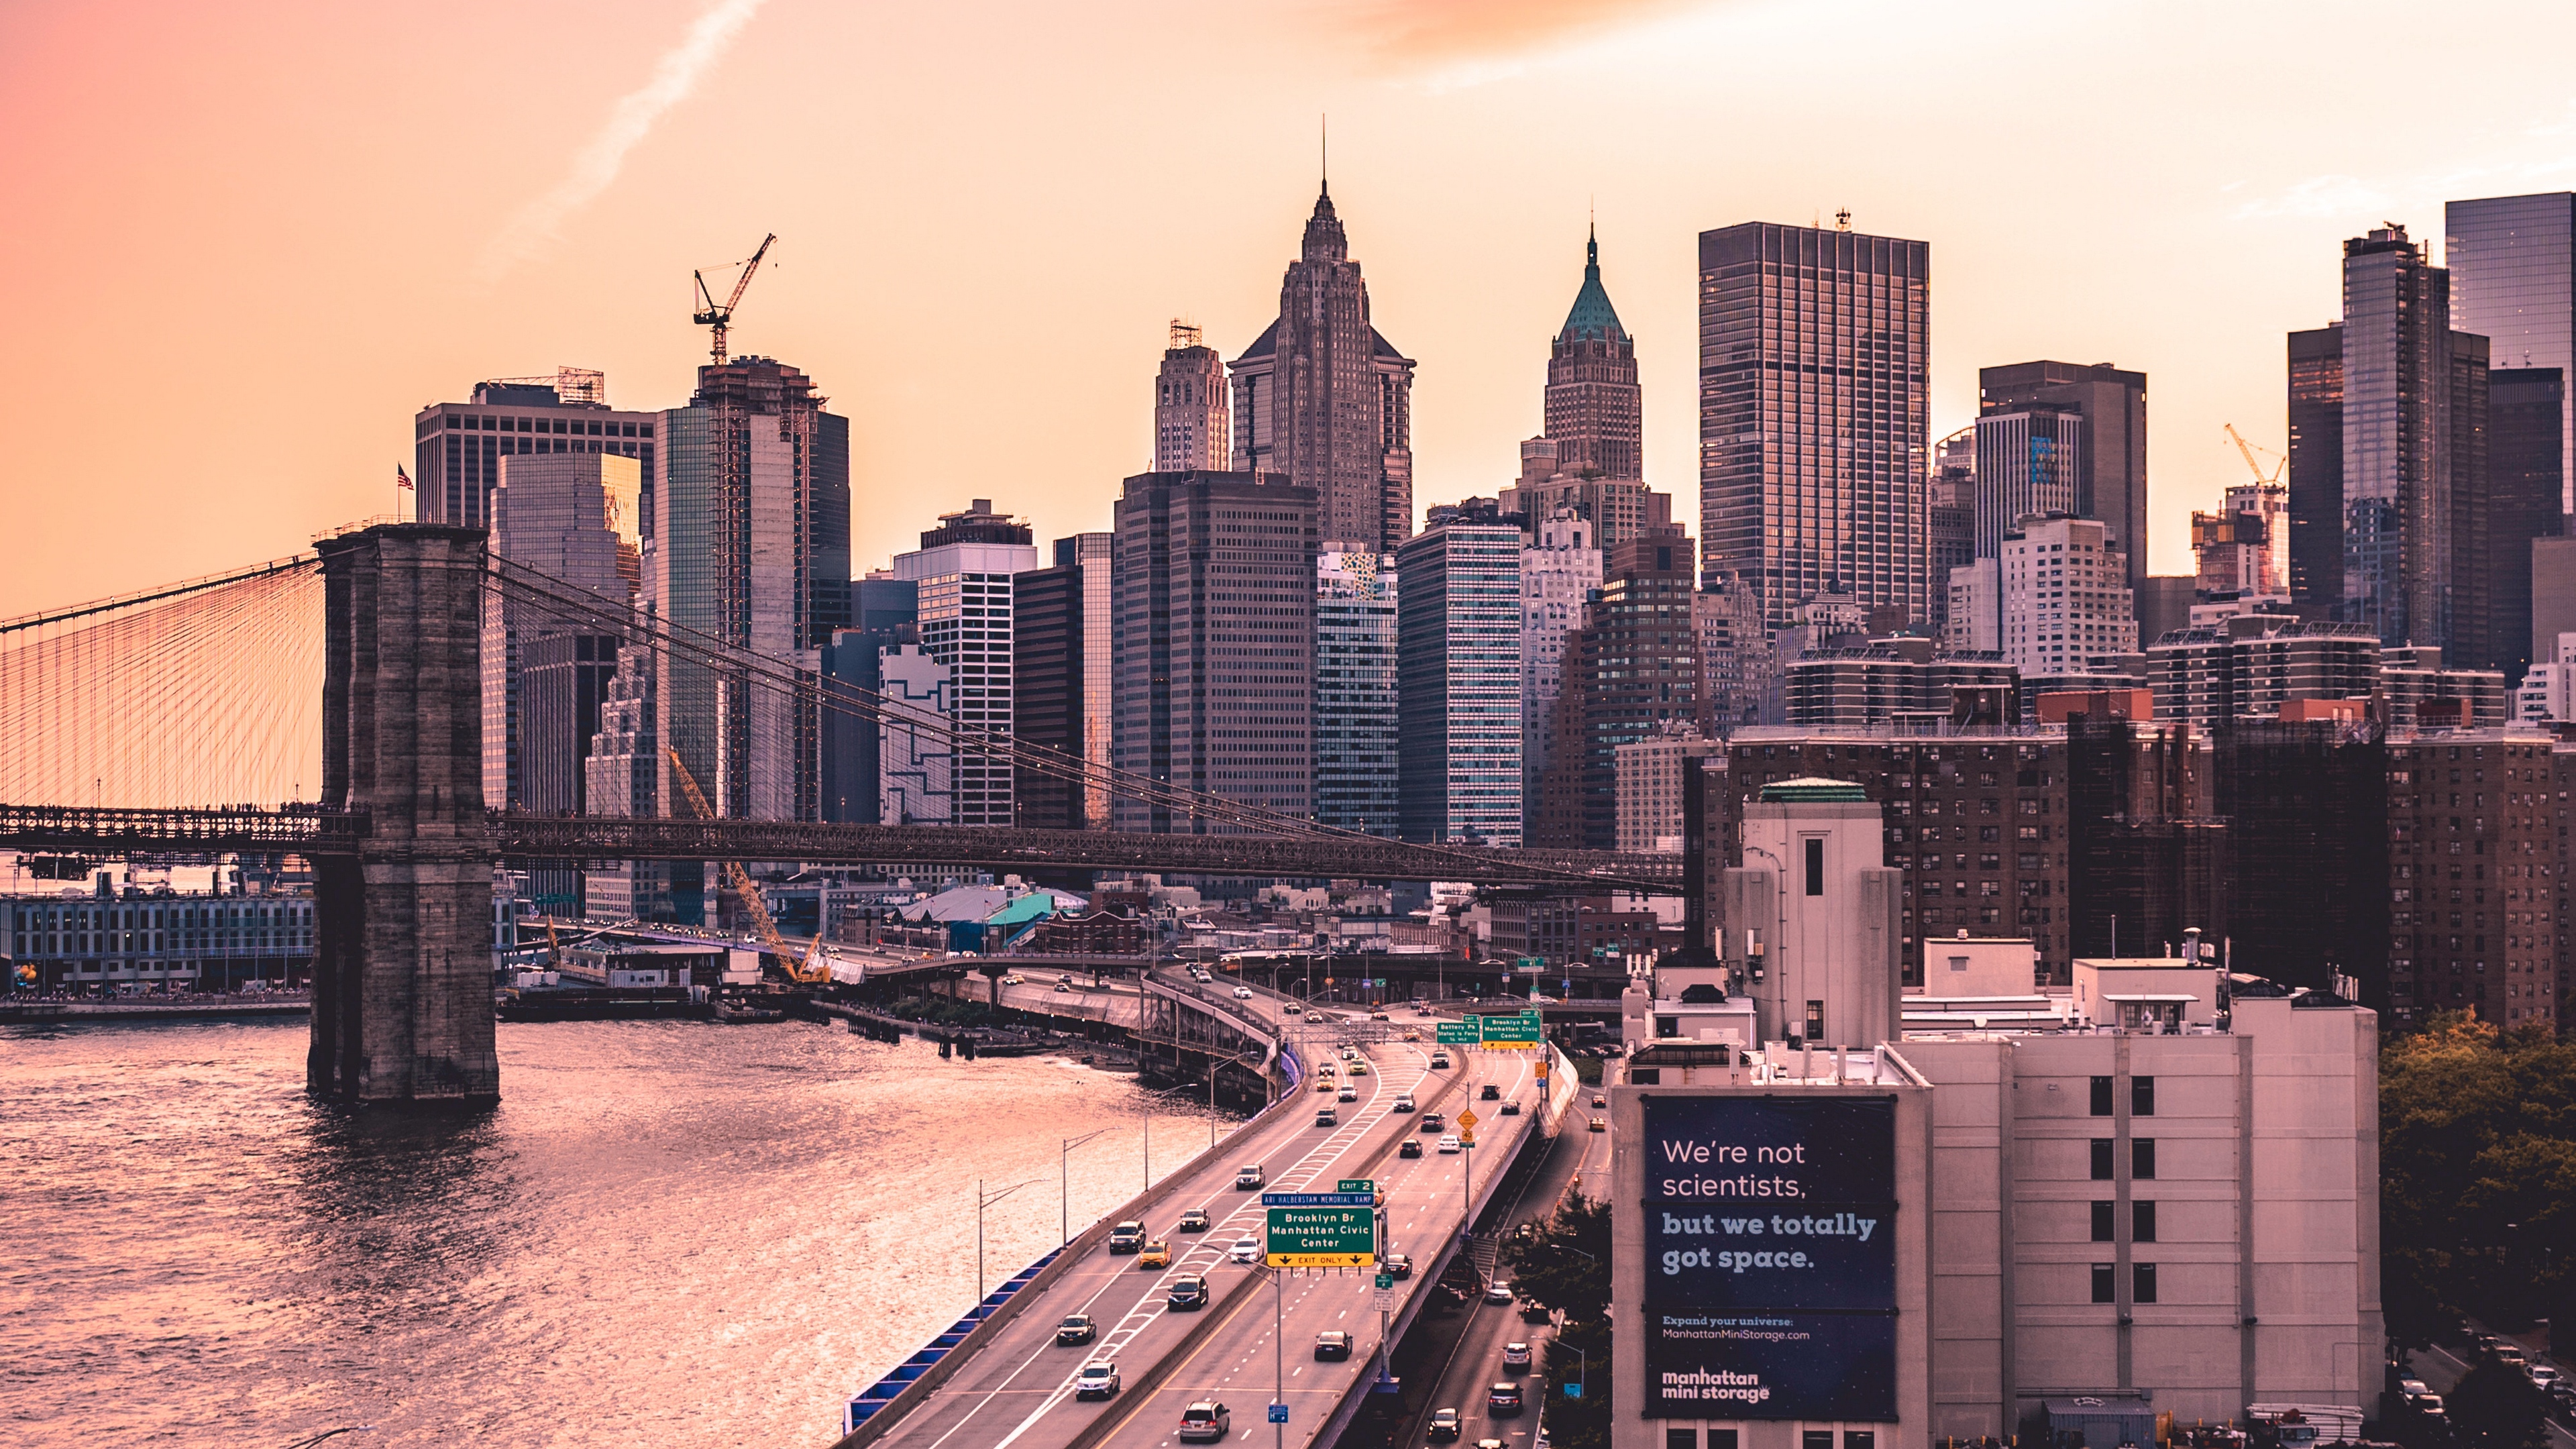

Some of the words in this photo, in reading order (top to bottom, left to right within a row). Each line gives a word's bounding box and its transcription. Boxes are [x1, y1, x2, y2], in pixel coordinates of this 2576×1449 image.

[1662, 1140, 1748, 1163] We're
[1758, 1142, 1805, 1163] not
[1362, 1182, 1370, 1190] 2
[1663, 1175, 1806, 1199] scientists,
[1285, 1214, 1337, 1224] Brooklyn
[1342, 1214, 1354, 1222] Br
[1272, 1226, 1334, 1235] Manhattan
[1340, 1226, 1368, 1234] Civic
[1662, 1213, 1715, 1235] but
[1722, 1218, 1764, 1234] we
[1771, 1213, 1876, 1242] totally
[1301, 1238, 1339, 1246] Center
[1662, 1248, 1711, 1275] got
[1719, 1251, 1814, 1273] space.
[1662, 1316, 1708, 1327] Expand
[1710, 1318, 1737, 1328] your
[1739, 1317, 1794, 1326] universe:
[1663, 1329, 1810, 1342] ManhattanMiniStorage.com
[1662, 1365, 1758, 1385] manhattan
[1662, 1385, 1699, 1399] mini
[1701, 1385, 1771, 1404] storage
